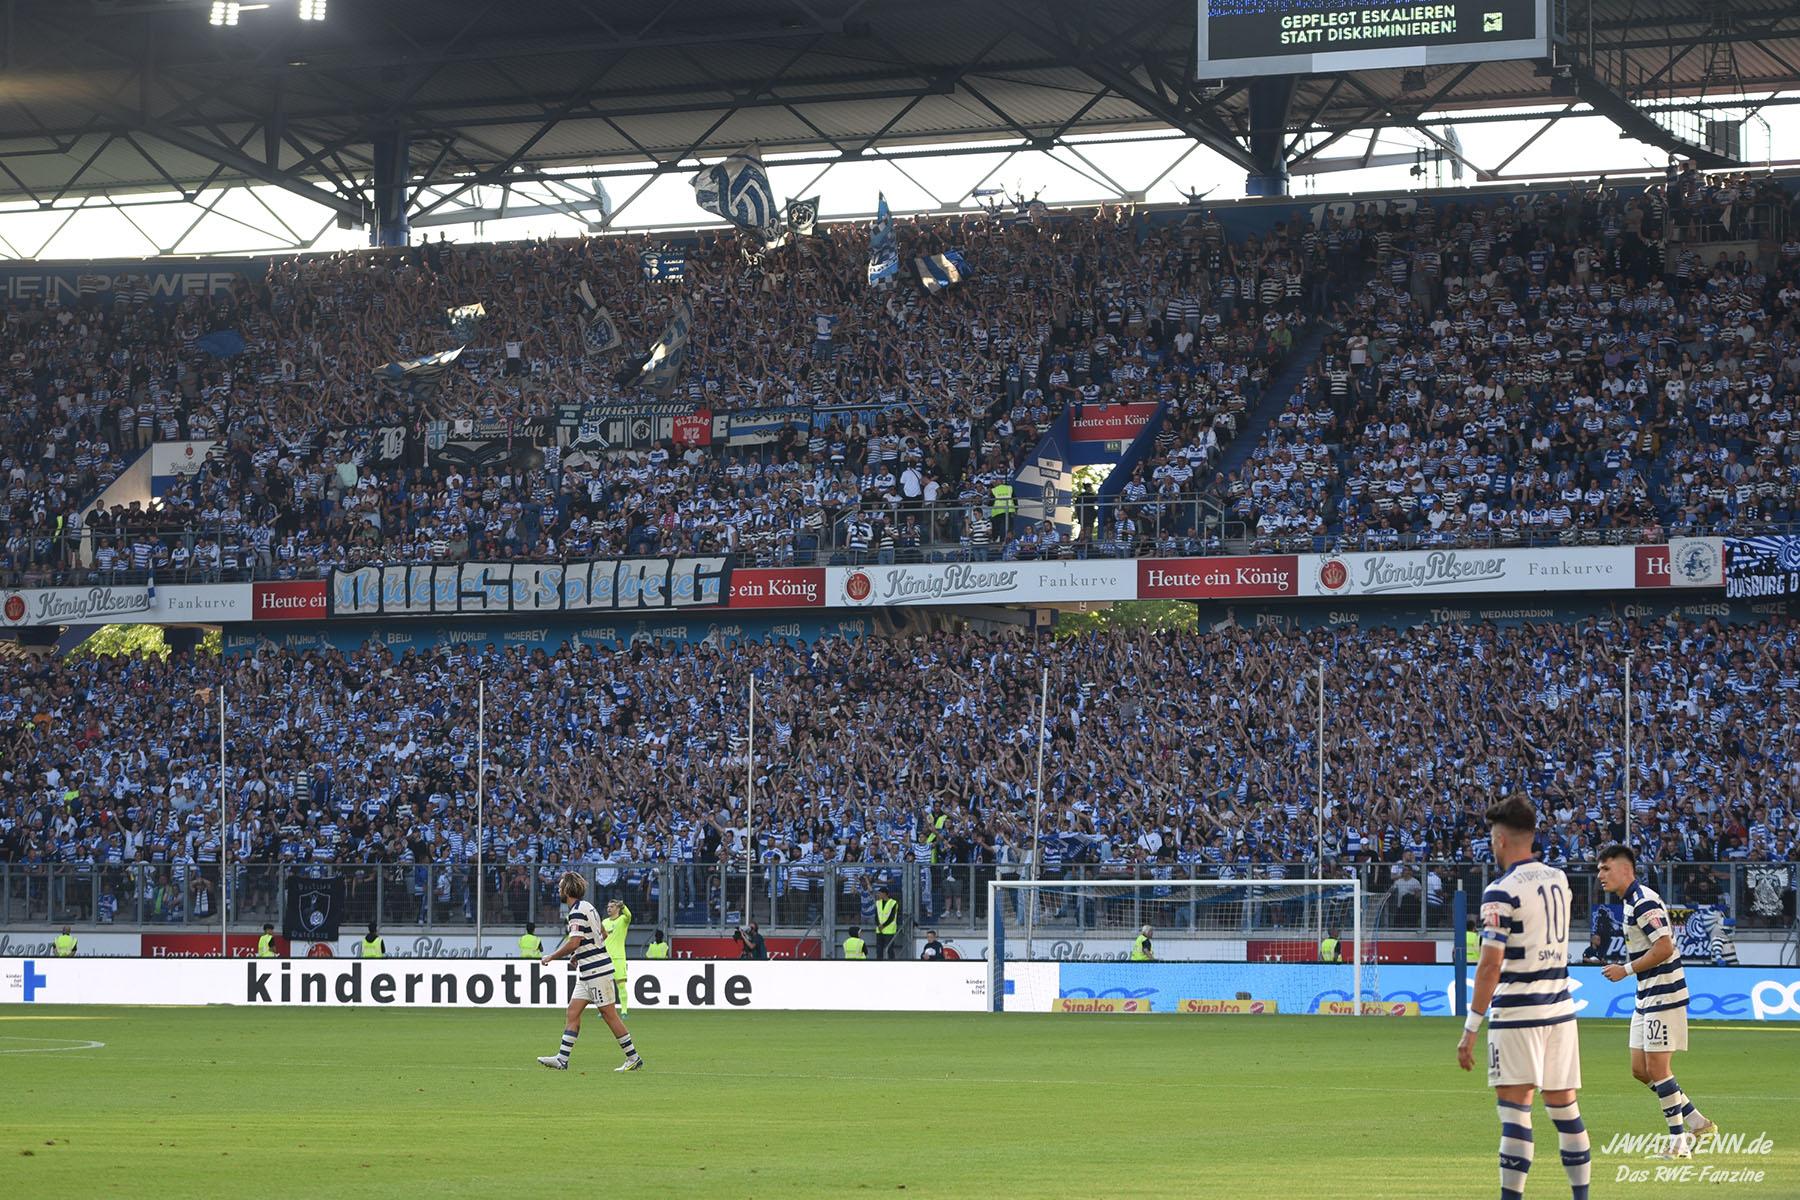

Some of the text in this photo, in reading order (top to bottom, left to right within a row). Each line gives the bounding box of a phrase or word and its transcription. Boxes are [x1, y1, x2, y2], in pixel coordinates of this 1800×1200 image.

[1281, 5, 1456, 29] GEPFLEGT ESKALIEREN
[1280, 20, 1457, 44] STATT DISKRIMINIEREN!
[676, 414, 710, 428] ULTRAS
[1360, 550, 1505, 588] König Pilsener
[1528, 562, 1614, 576] Fankurve
[883, 563, 1018, 598] König Pilsener
[1039, 574, 1117, 588] Fankurve
[1147, 567, 1289, 590] Heute ein König
[334, 556, 727, 616] DUISBURG
[738, 585, 764, 598] ein
[768, 578, 817, 602] König
[1726, 575, 1786, 598] DUISBURG
[36, 592, 88, 619] König
[168, 598, 235, 609] Fankurve
[261, 593, 307, 610] Heute
[1751, 601, 1787, 614] HEINZE
[1479, 609, 1554, 619] WEDAUSTADION
[1685, 602, 1731, 616] WOLTERS
[1256, 614, 1284, 627] DIETZ
[387, 632, 413, 644] BELLA
[449, 630, 487, 643] WOHLERT
[503, 628, 549, 642] MACHEREY
[581, 626, 616, 640] KRÄMER
[1536, 884, 1566, 945] 10
[247, 961, 753, 1006] kindernothie.de
[1061, 999, 1115, 1013] Sinalco
[1187, 999, 1241, 1014] Sinalco
[1328, 1001, 1383, 1015] Sinlco
[1646, 1019, 1662, 1040] 32
